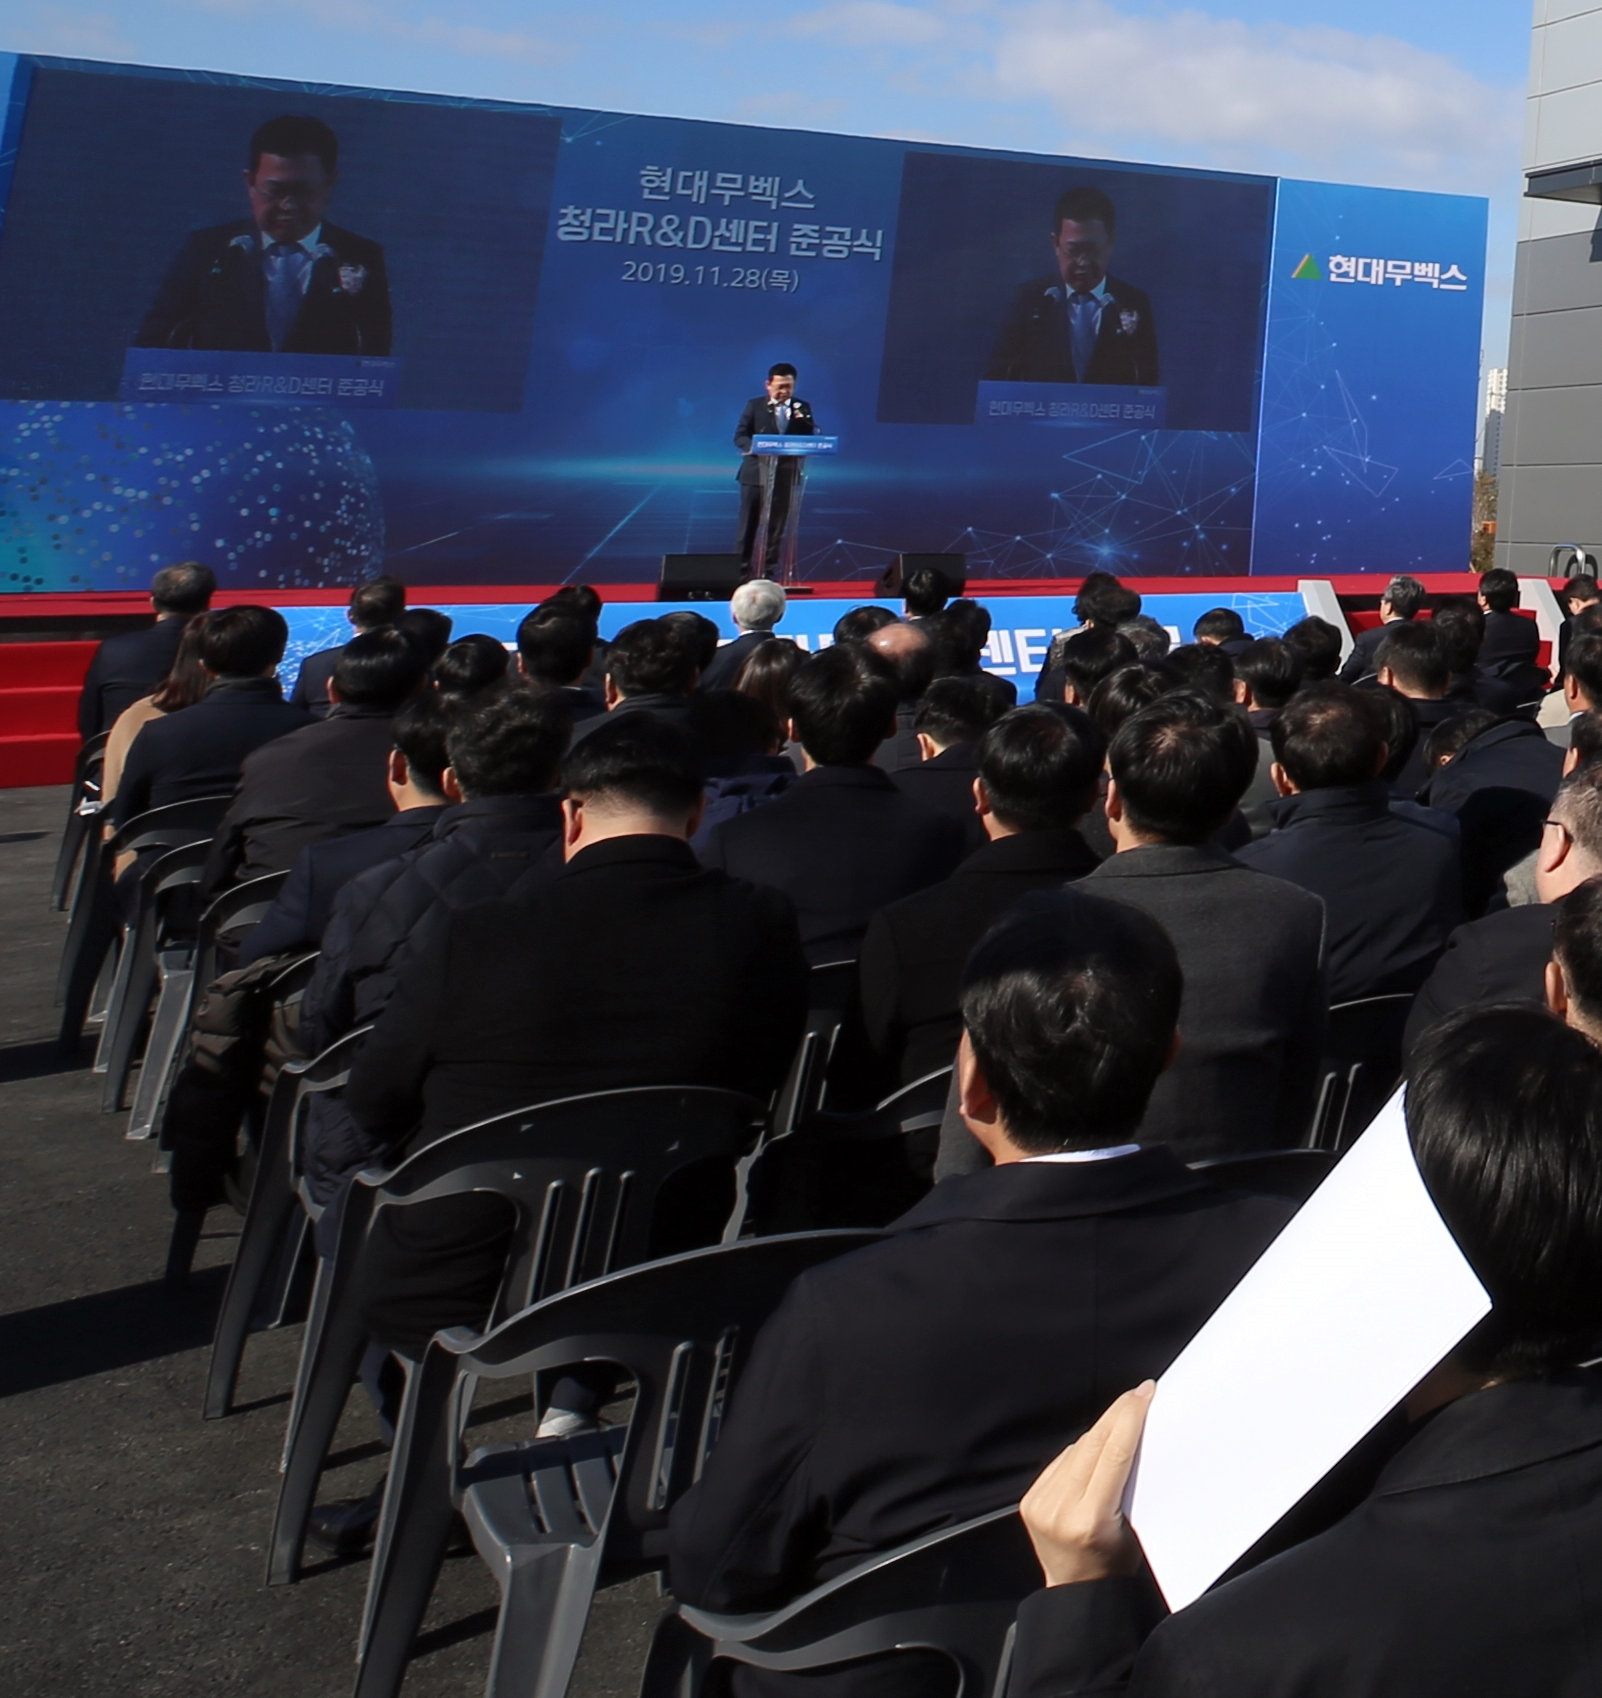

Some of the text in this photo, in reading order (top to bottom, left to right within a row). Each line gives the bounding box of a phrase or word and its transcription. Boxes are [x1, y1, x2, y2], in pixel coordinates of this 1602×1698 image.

[639, 165, 816, 210] 현대무벡스
[557, 205, 884, 261] 청라R&D센터 준공식
[621, 261, 799, 293] 2019.11.28(목)
[1328, 254, 1468, 291] 현대무벡스
